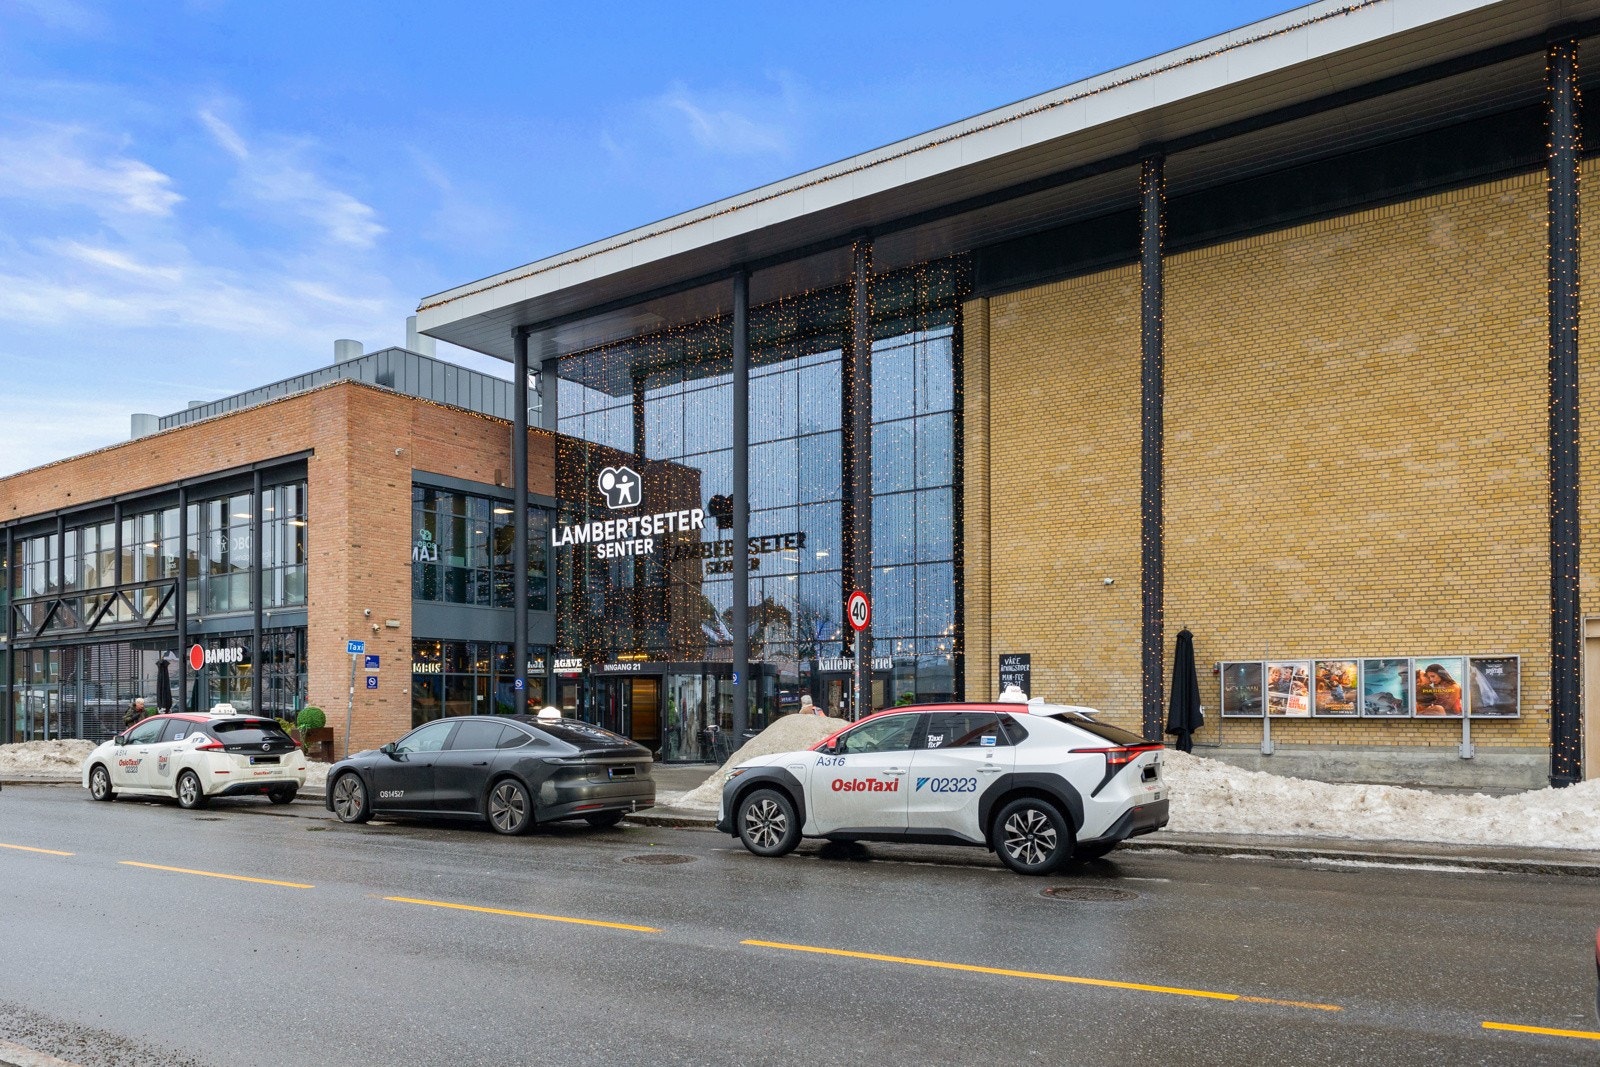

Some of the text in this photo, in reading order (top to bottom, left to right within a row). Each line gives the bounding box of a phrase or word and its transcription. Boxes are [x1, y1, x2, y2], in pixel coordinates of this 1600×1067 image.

[552, 508, 705, 547] LAMBERTSETER
[597, 539, 654, 560] SENTER
[852, 602, 866, 621] 40
[349, 642, 364, 651] Taxi
[205, 647, 243, 664] BAMBUS
[553, 658, 582, 668] AGAVE
[818, 655, 894, 671] Kaffebreriet
[604, 663, 641, 671] INNGANG 21
[927, 734, 944, 742] Taxi
[816, 757, 846, 767] A316
[831, 778, 899, 792] OsloTaxi
[930, 777, 978, 793] 02323
